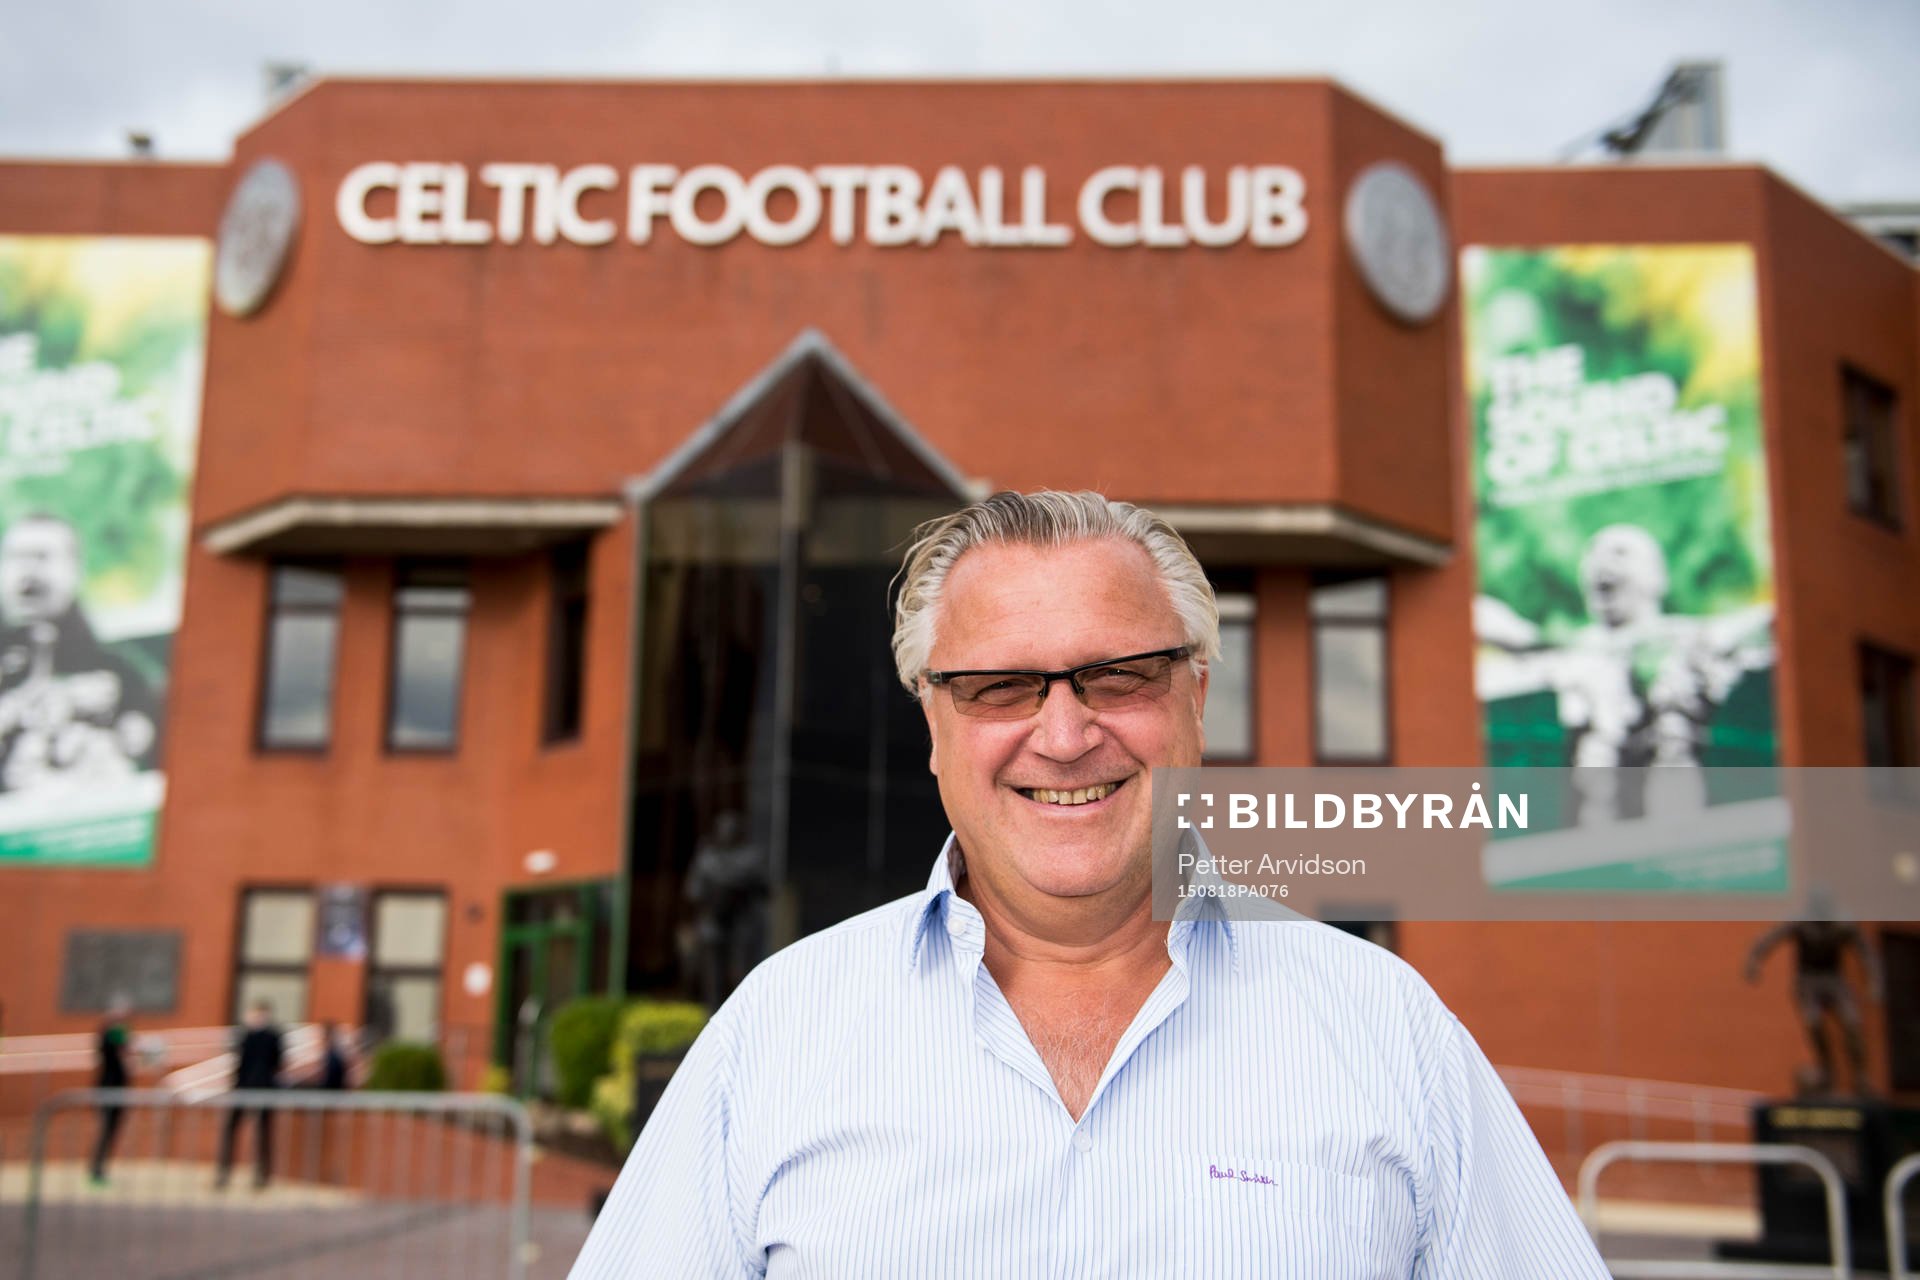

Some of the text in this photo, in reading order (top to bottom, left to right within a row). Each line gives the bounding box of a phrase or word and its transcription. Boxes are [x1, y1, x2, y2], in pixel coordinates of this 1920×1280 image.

[336, 162, 1309, 248] CELTIC FOOTBALL CLUB
[1209, 1164, 1239, 1179] Paul
